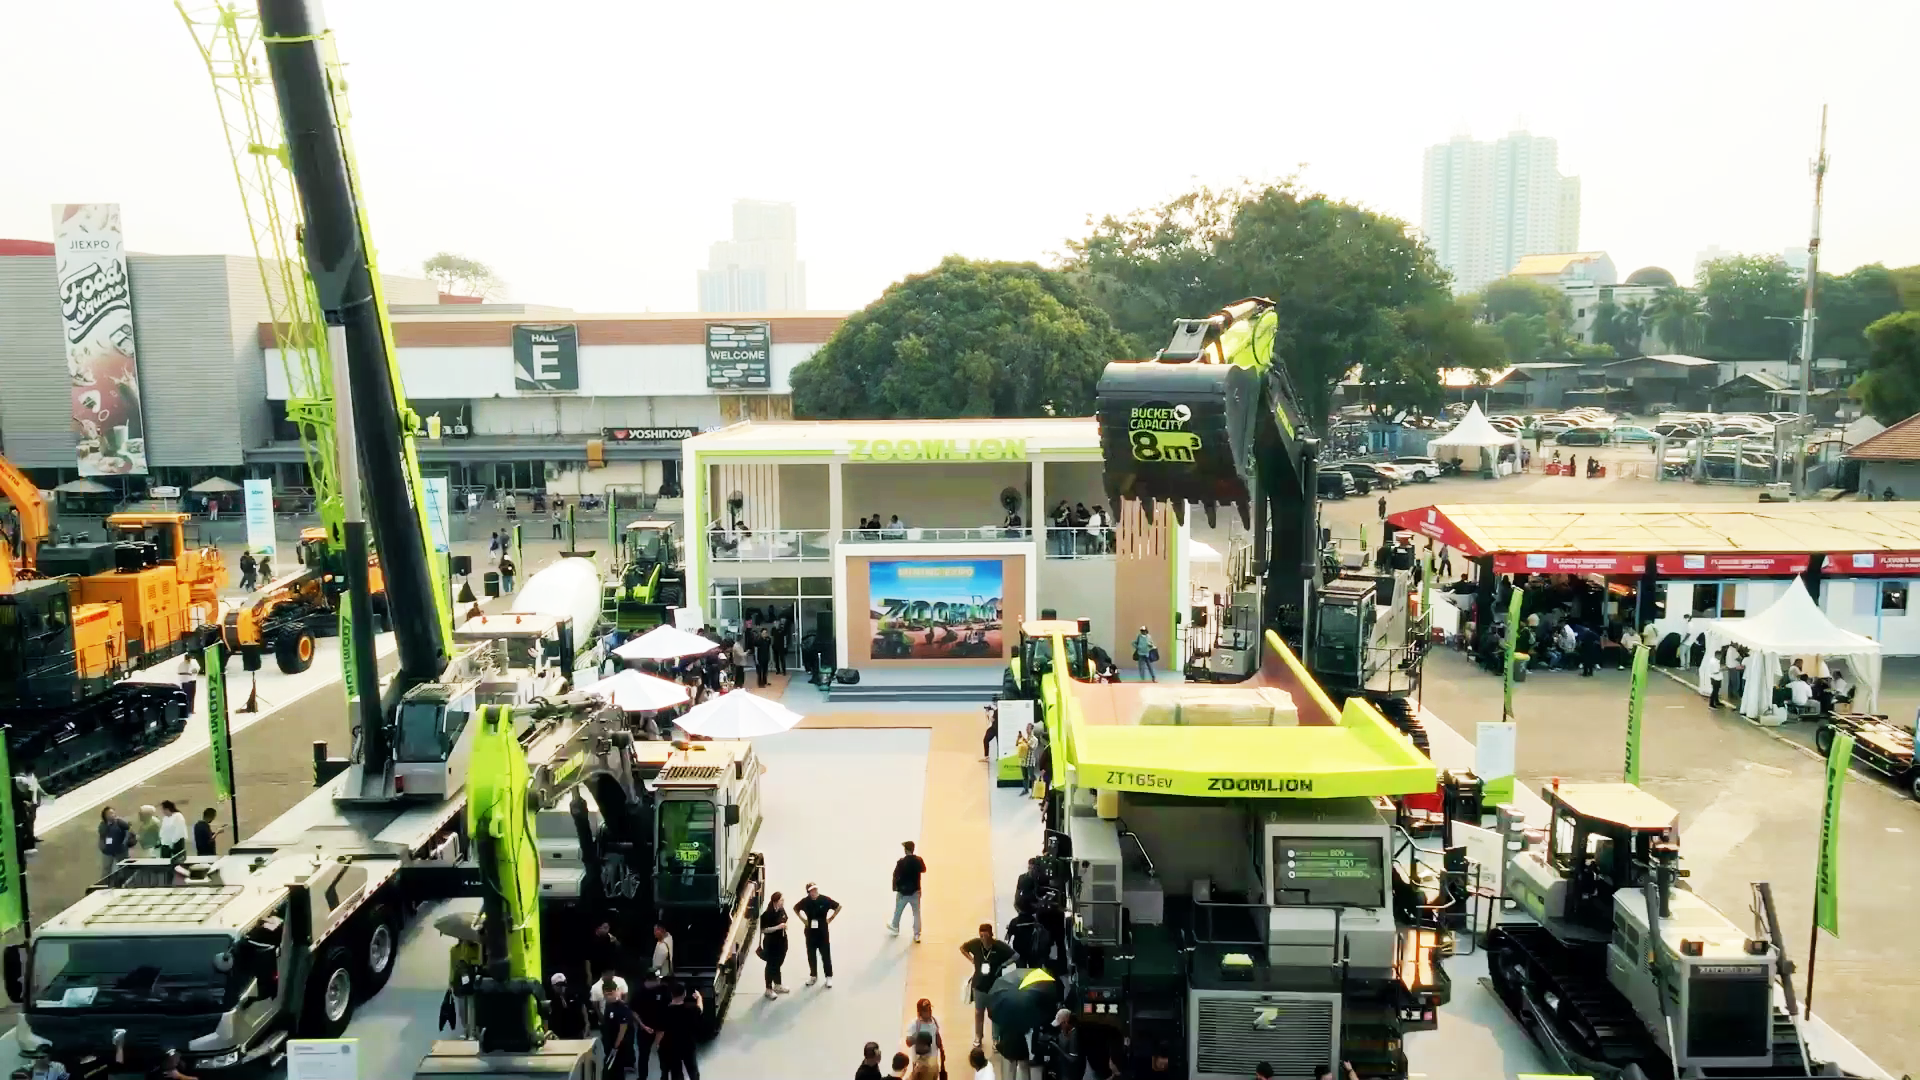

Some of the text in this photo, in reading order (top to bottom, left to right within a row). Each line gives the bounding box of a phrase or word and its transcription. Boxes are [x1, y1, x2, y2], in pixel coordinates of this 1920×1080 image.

[69, 240, 110, 249] JIEXPO
[60, 259, 126, 320] Food
[76, 284, 127, 324] Square
[531, 333, 558, 343] HALL
[710, 350, 765, 361] WELCOME
[532, 344, 561, 380] E
[1131, 407, 1176, 419] BUCKET
[1130, 418, 1184, 430] CAPACITY
[628, 429, 693, 439] YOSHINOYA
[847, 438, 1026, 461] ZOOMLION
[1208, 778, 1313, 792] ZOOMLION
